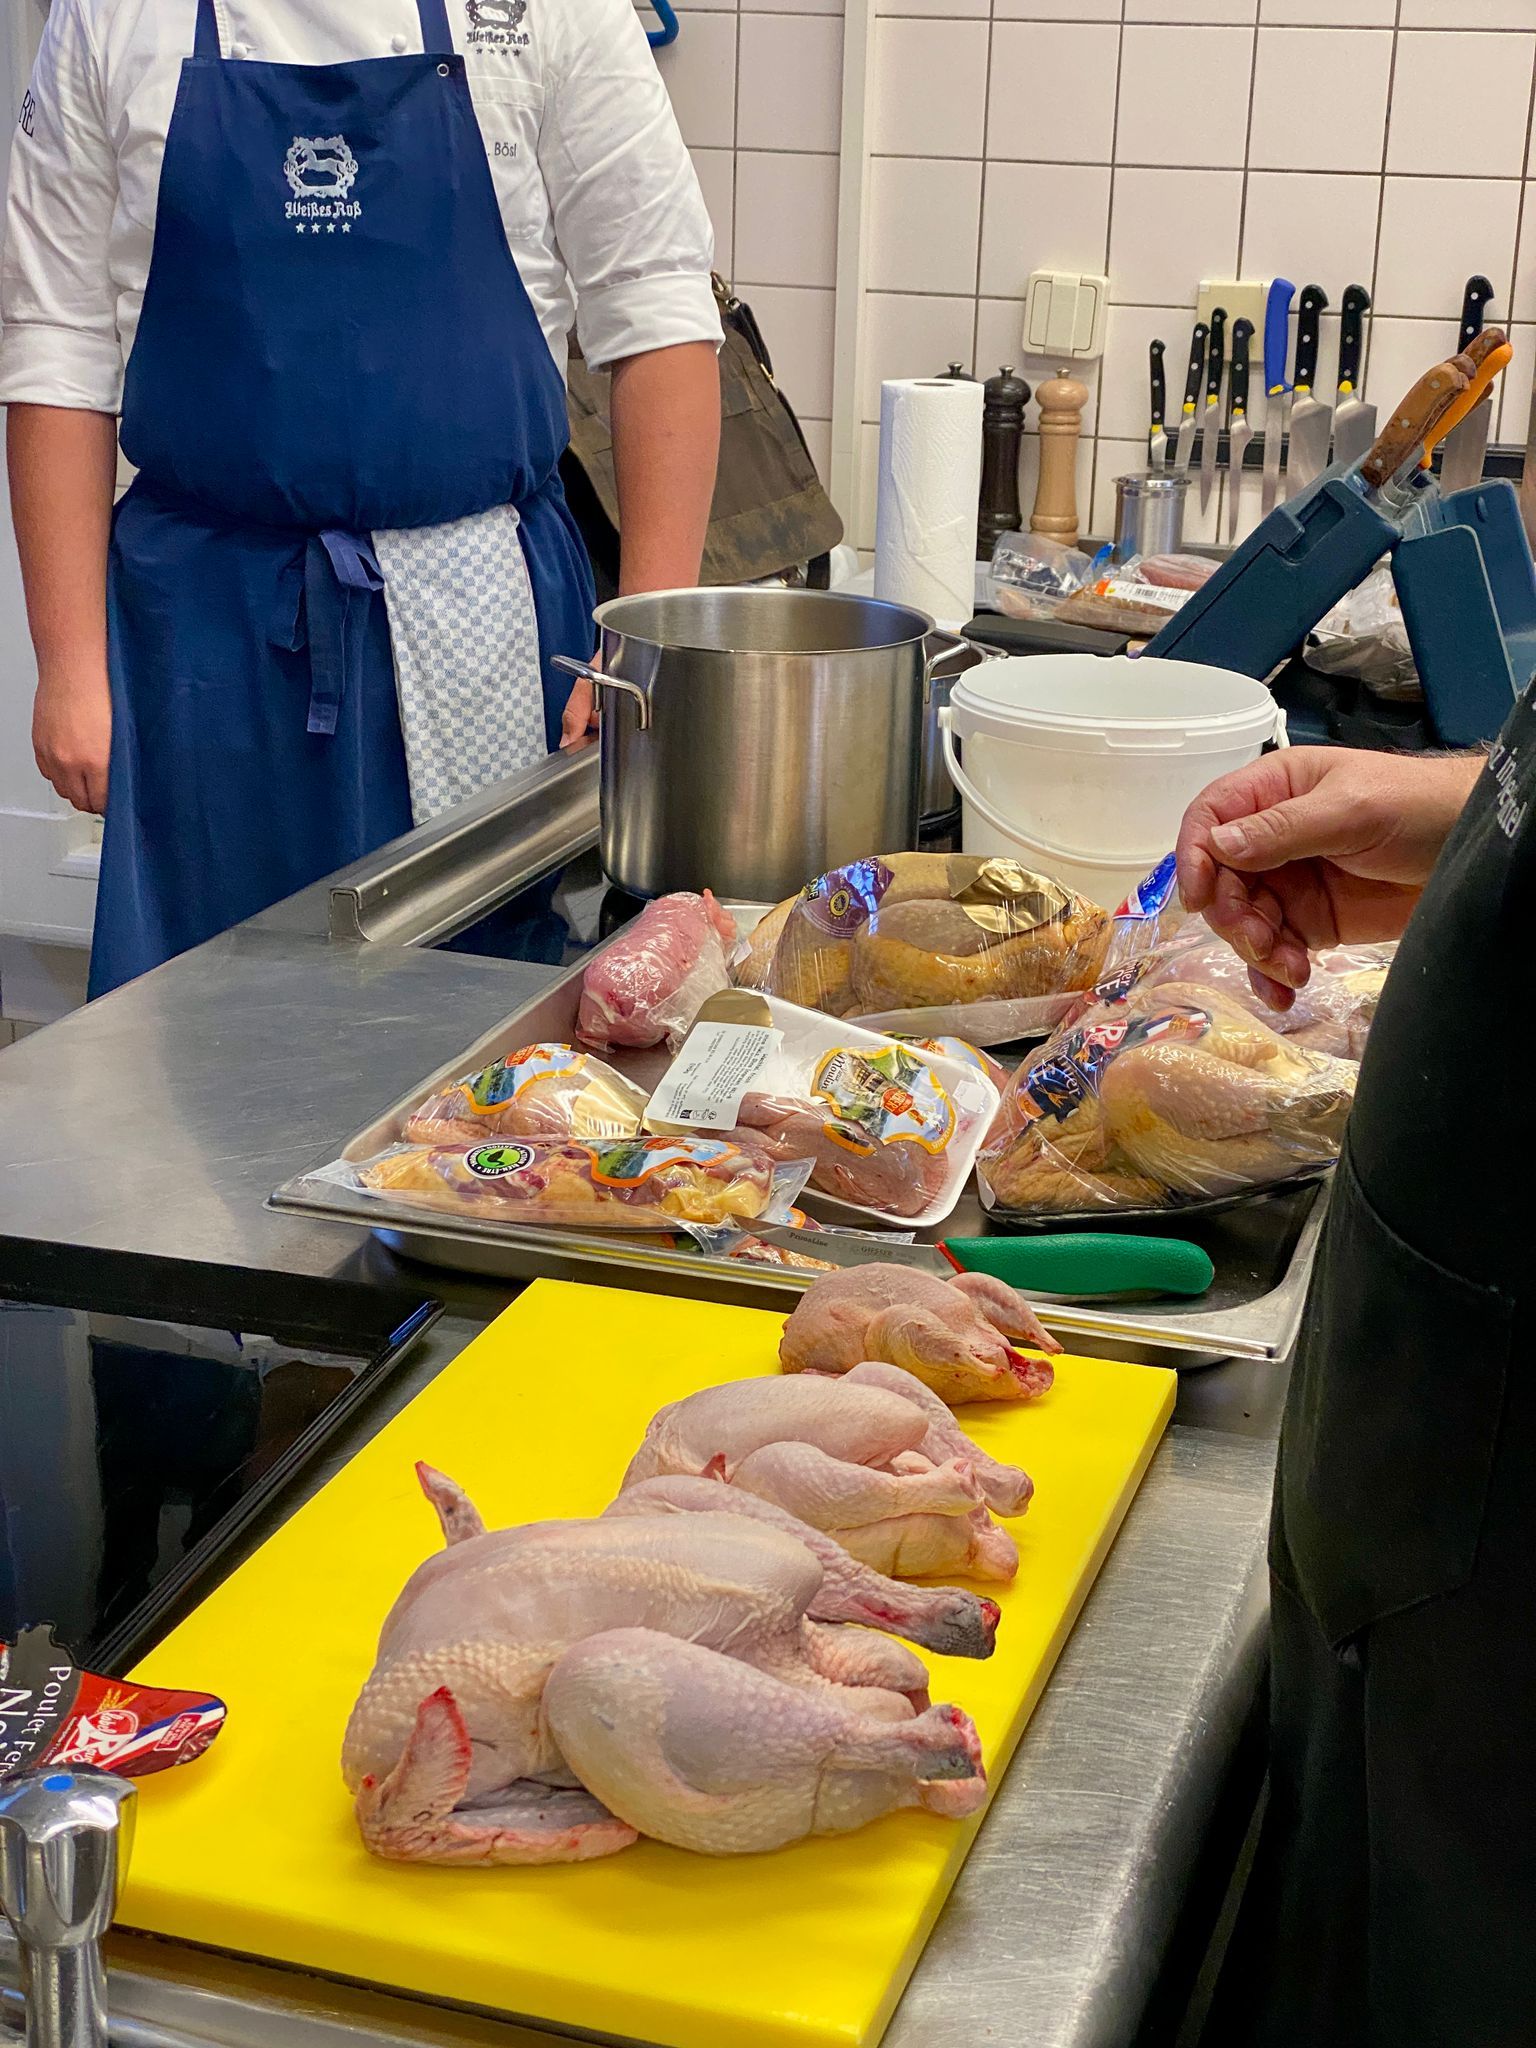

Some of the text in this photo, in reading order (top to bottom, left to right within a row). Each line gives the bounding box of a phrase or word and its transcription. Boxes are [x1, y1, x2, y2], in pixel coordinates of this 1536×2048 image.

[285, 201, 362, 220] Weißes Roß
[21, 1666, 73, 1735] Poulet
